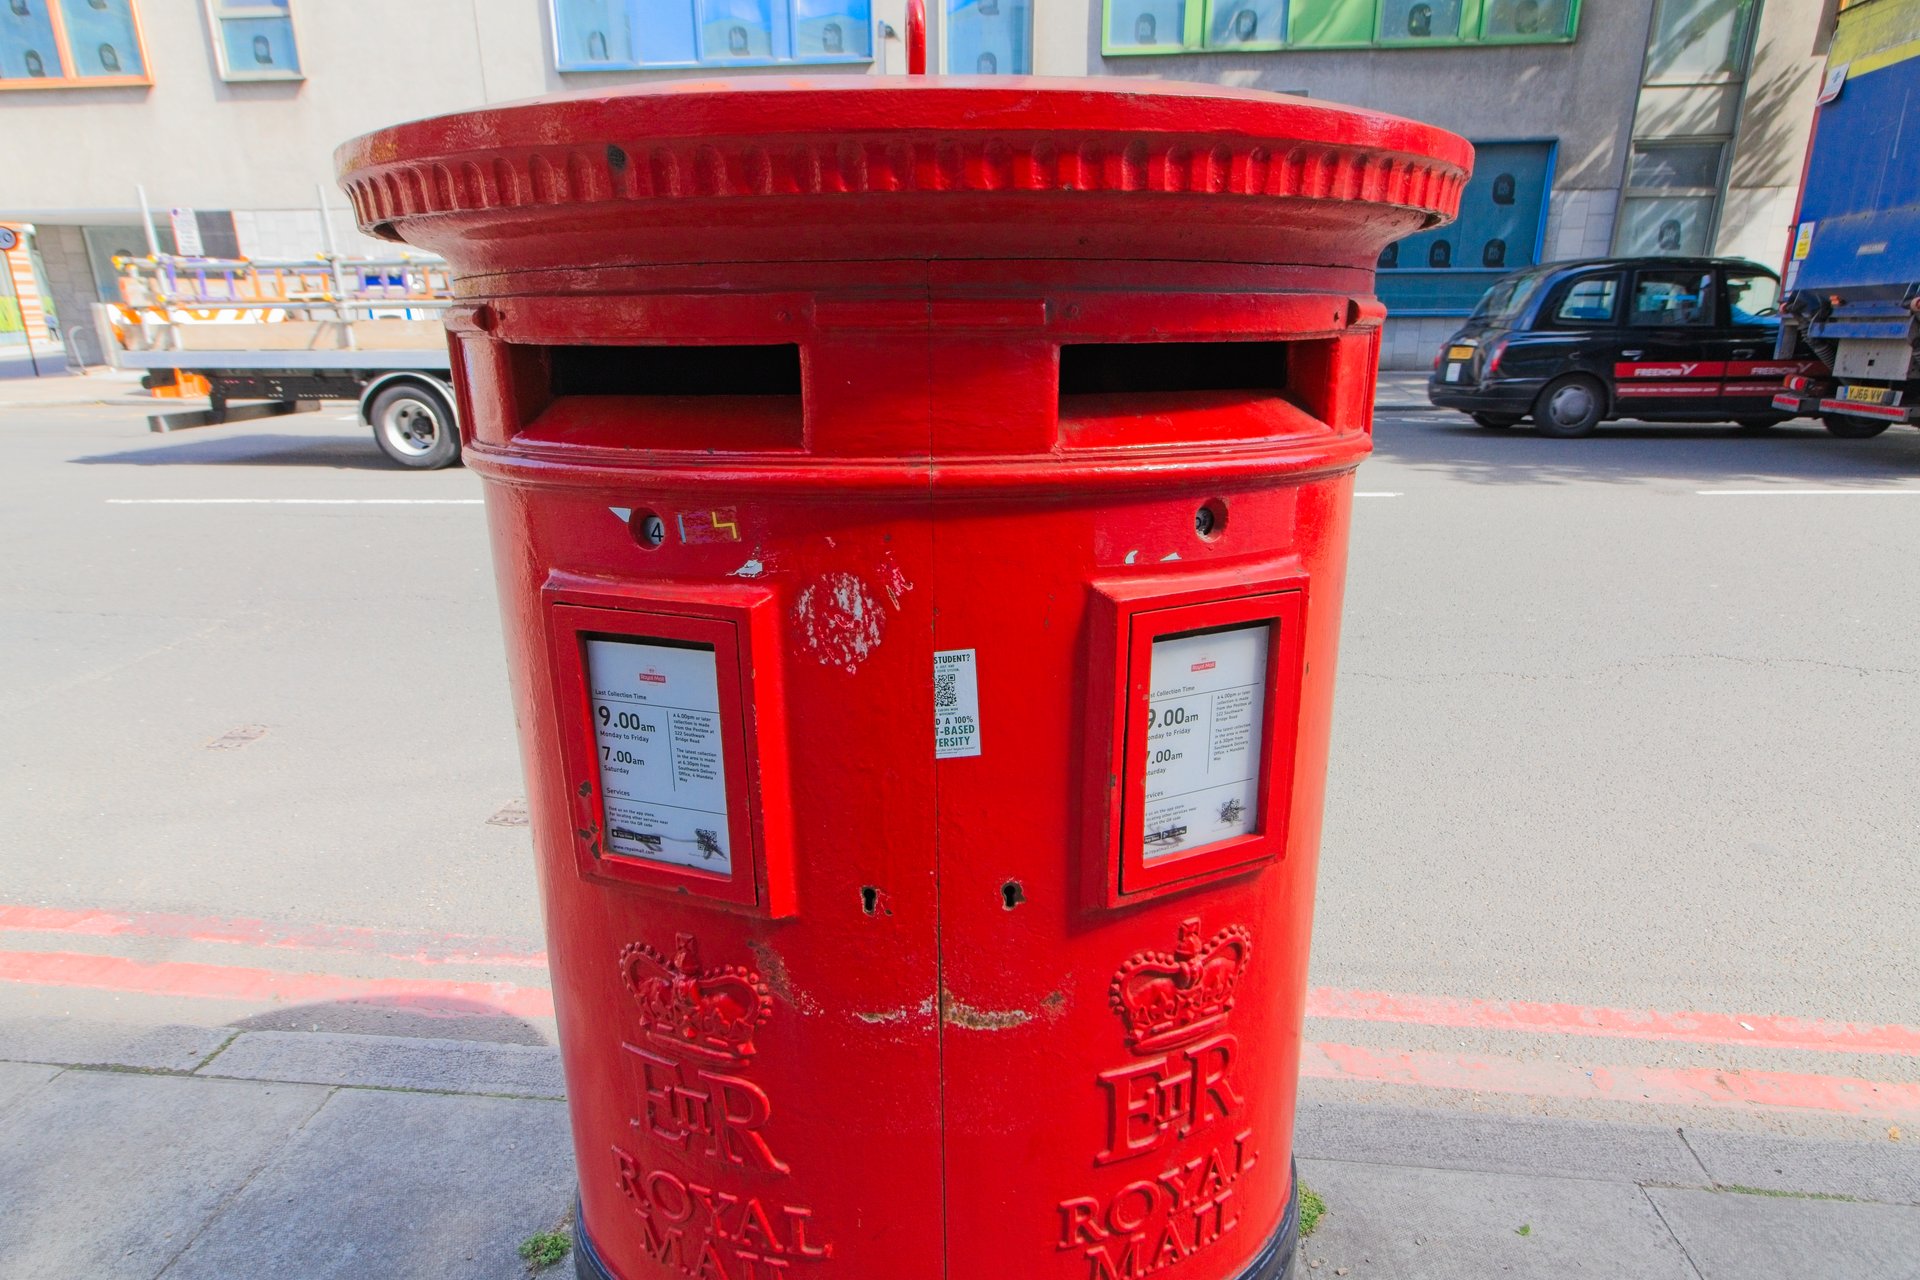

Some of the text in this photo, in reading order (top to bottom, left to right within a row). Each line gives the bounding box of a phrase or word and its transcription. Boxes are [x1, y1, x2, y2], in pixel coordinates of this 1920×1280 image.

[651, 522, 664, 542] 4
[934, 654, 970, 664] STUDENT?
[608, 690, 632, 698] Collection
[1156, 688, 1181, 696] Collection
[598, 706, 656, 732] 9.00am
[600, 730, 622, 740] Monday
[631, 734, 649, 743] Friday
[602, 746, 644, 766] 7.00am
[604, 765, 629, 774] Saturday
[1146, 768, 1166, 776] turday
[606, 788, 630, 796] Services
[1056, 1127, 1259, 1252] ROYAL
[611, 1144, 833, 1258] ROYAL
[1085, 1187, 1241, 1280] MAIL
